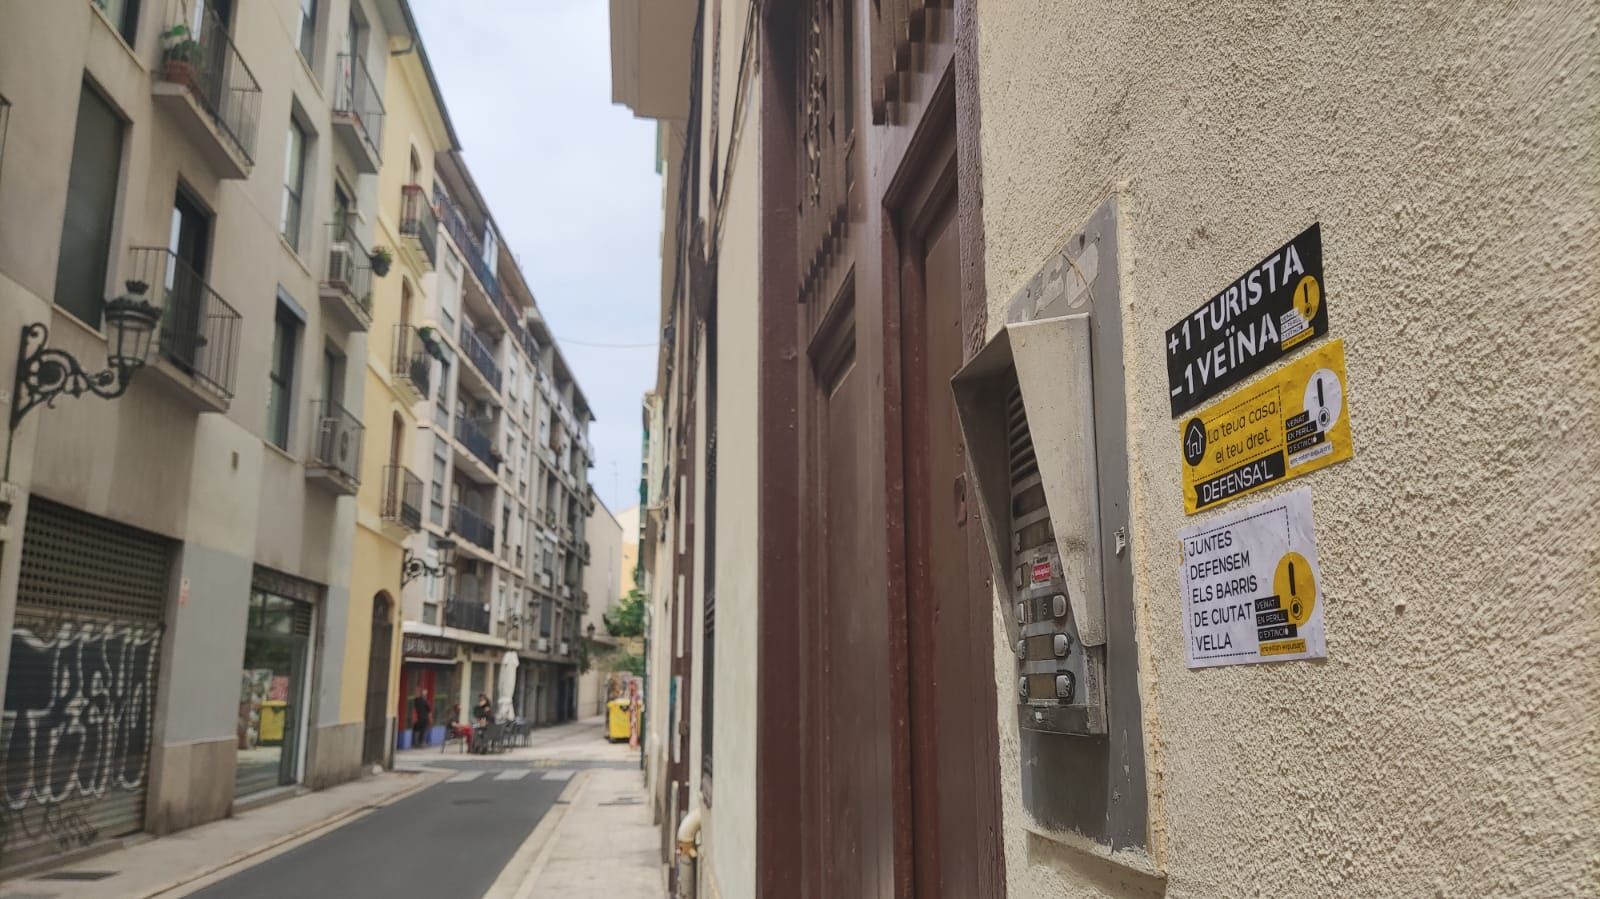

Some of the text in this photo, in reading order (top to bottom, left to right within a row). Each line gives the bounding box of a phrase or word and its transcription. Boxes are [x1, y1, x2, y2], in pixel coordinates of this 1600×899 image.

[1168, 244, 1304, 354] +1 TURISTA
[1197, 313, 1279, 386] VEÏNA
[1208, 401, 1279, 444] La teua casa,
[1286, 414, 1305, 428] VENAT
[1215, 426, 1271, 463] el teu dret.
[1188, 530, 1232, 557] JUNTES
[1190, 551, 1250, 580] DEFENSEM
[1192, 575, 1258, 604] ELS BARRIS
[1194, 602, 1252, 628] DE CIUTAT
[1256, 599, 1275, 610] VENAT
[1195, 632, 1232, 651] VELLA
